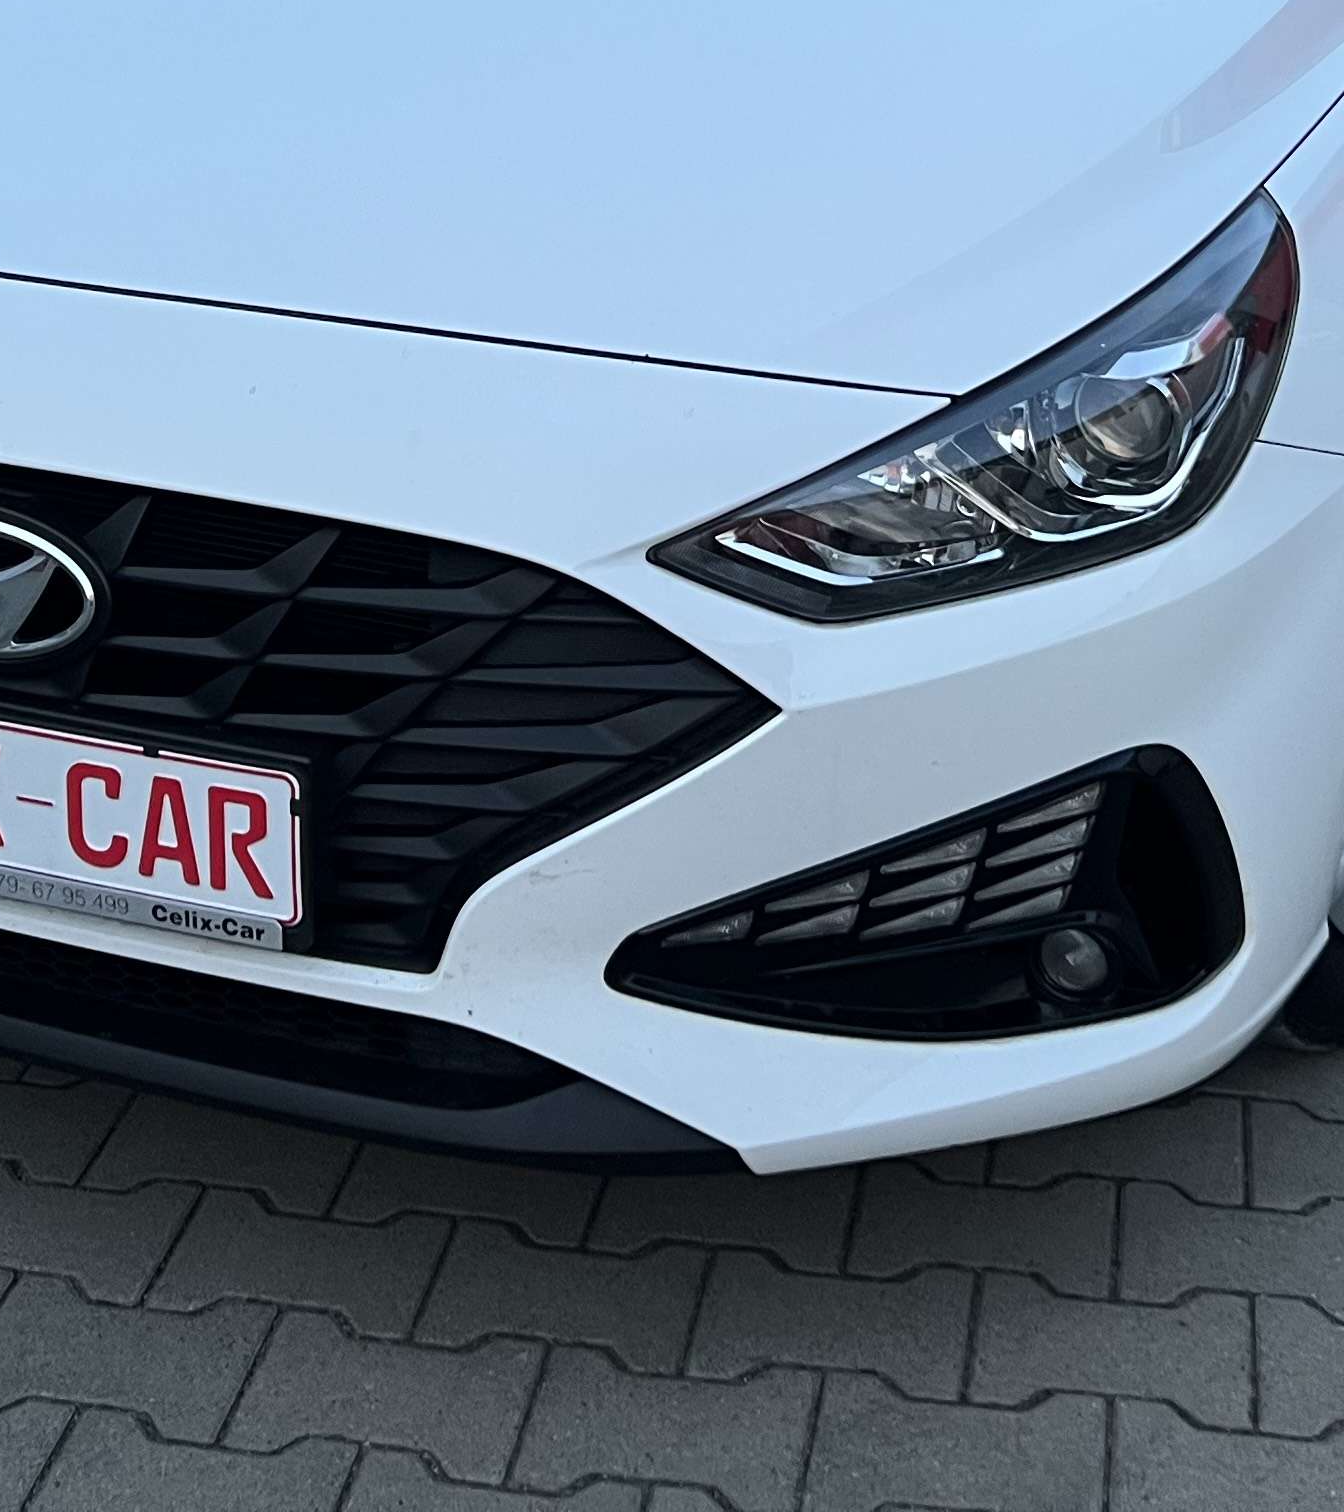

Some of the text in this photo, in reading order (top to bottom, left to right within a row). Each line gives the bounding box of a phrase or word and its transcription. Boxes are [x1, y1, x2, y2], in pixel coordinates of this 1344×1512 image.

[32, 880, 54, 901] 67
[63, 886, 86, 906] 95
[93, 892, 130, 915] 499
[151, 904, 265, 941] Celix-Car
